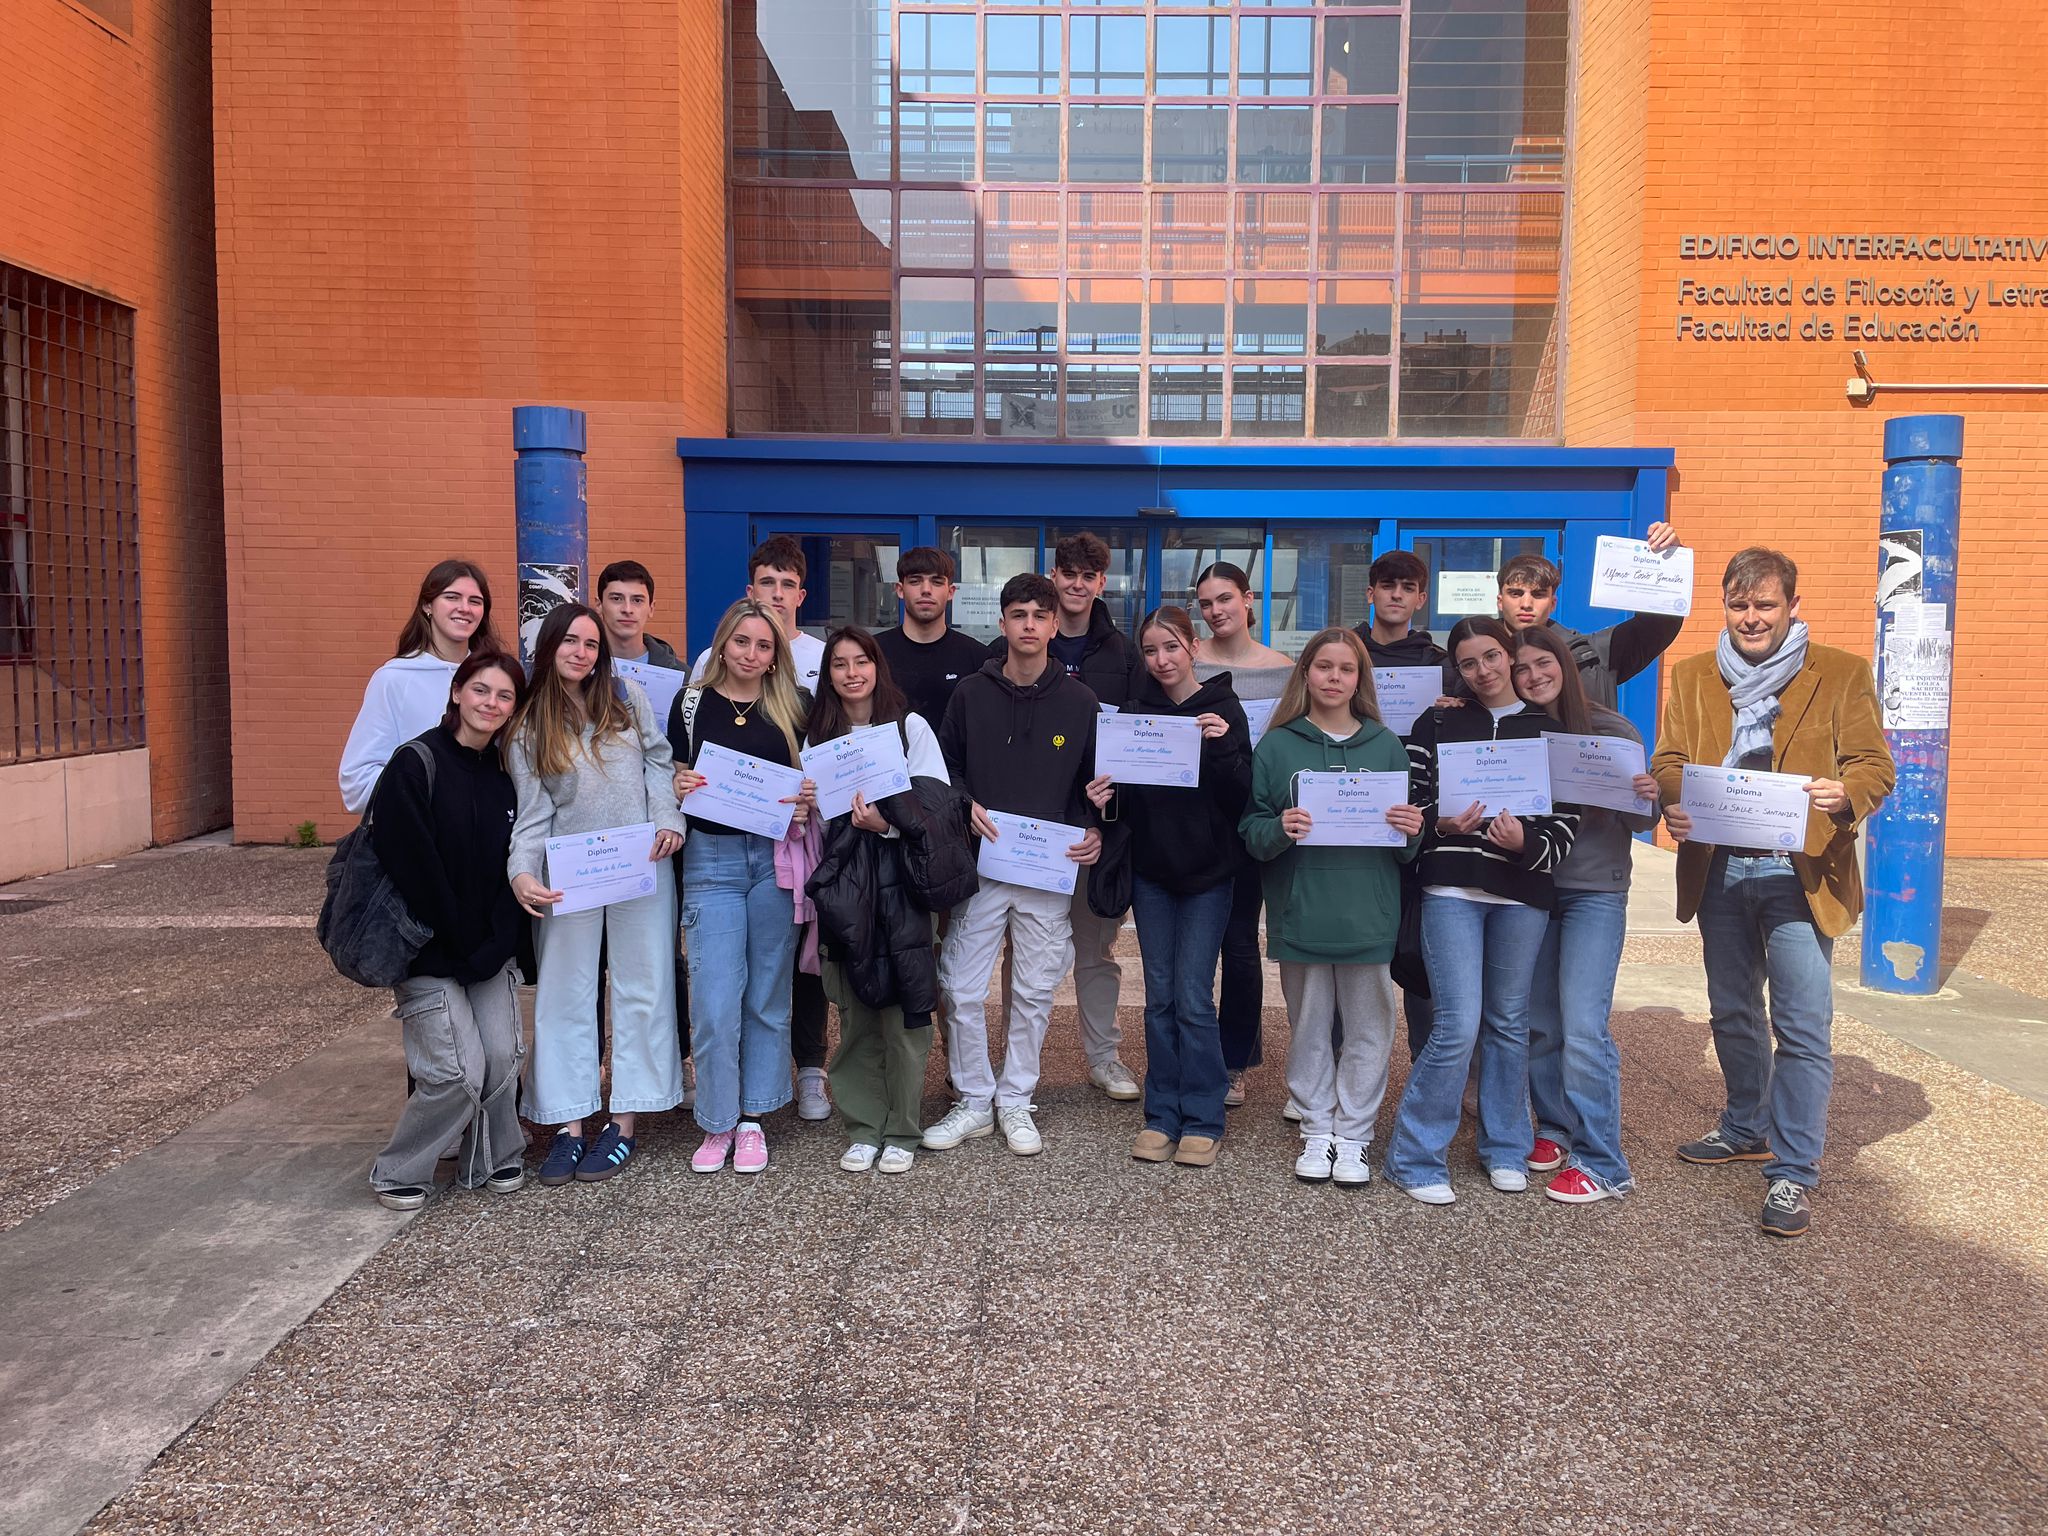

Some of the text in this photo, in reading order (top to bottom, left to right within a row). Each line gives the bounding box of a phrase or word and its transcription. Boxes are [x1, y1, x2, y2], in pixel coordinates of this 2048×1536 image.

[1680, 234, 2048, 262] EDIFICIO INTERFACULTATIV
[1678, 277, 1793, 306] Facultad
[1801, 277, 1835, 305] de
[1845, 276, 1956, 307] Filosofía
[1963, 286, 1979, 314] y
[1676, 312, 1980, 342] Facultad de Educación
[1112, 404, 1136, 419] UC
[1633, 555, 1660, 565] Diploma
[1134, 730, 1164, 738] Diploma
[704, 748, 715, 756] UC
[836, 747, 864, 761] Diploma
[1580, 752, 1612, 761] Diploma
[803, 754, 814, 762] UC
[1476, 758, 1507, 766] Diploma
[734, 769, 764, 784] Diploma
[1687, 770, 1699, 778] UC
[1338, 789, 1369, 797] Diploma
[1726, 786, 1762, 797] Diploma
[1718, 802, 1728, 811] LA
[1019, 832, 1047, 843] Diploma
[587, 846, 618, 857] Diploma
